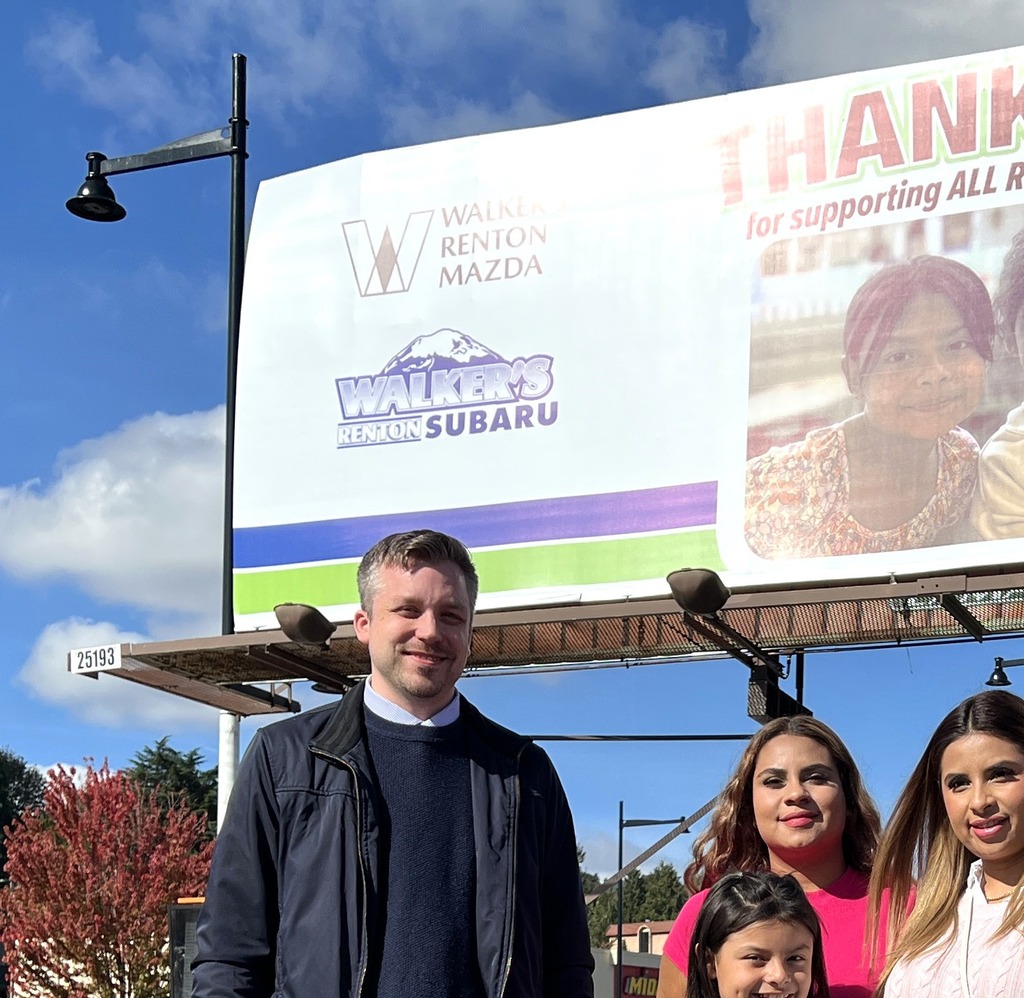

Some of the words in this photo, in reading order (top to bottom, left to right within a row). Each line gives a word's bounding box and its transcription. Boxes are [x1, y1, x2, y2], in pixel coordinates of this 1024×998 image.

[441, 193, 567, 228] WALKER
[746, 210, 785, 240] for
[789, 178, 942, 231] supporting
[947, 164, 996, 200] ALL
[441, 224, 547, 259] RENTON
[439, 254, 543, 289] MAZDA
[335, 354, 554, 420] WALKER'S
[337, 418, 422, 446] RENTON
[425, 401, 558, 439] SUBARU
[77, 647, 115, 669] 25193
[628, 977, 657, 996] MID
